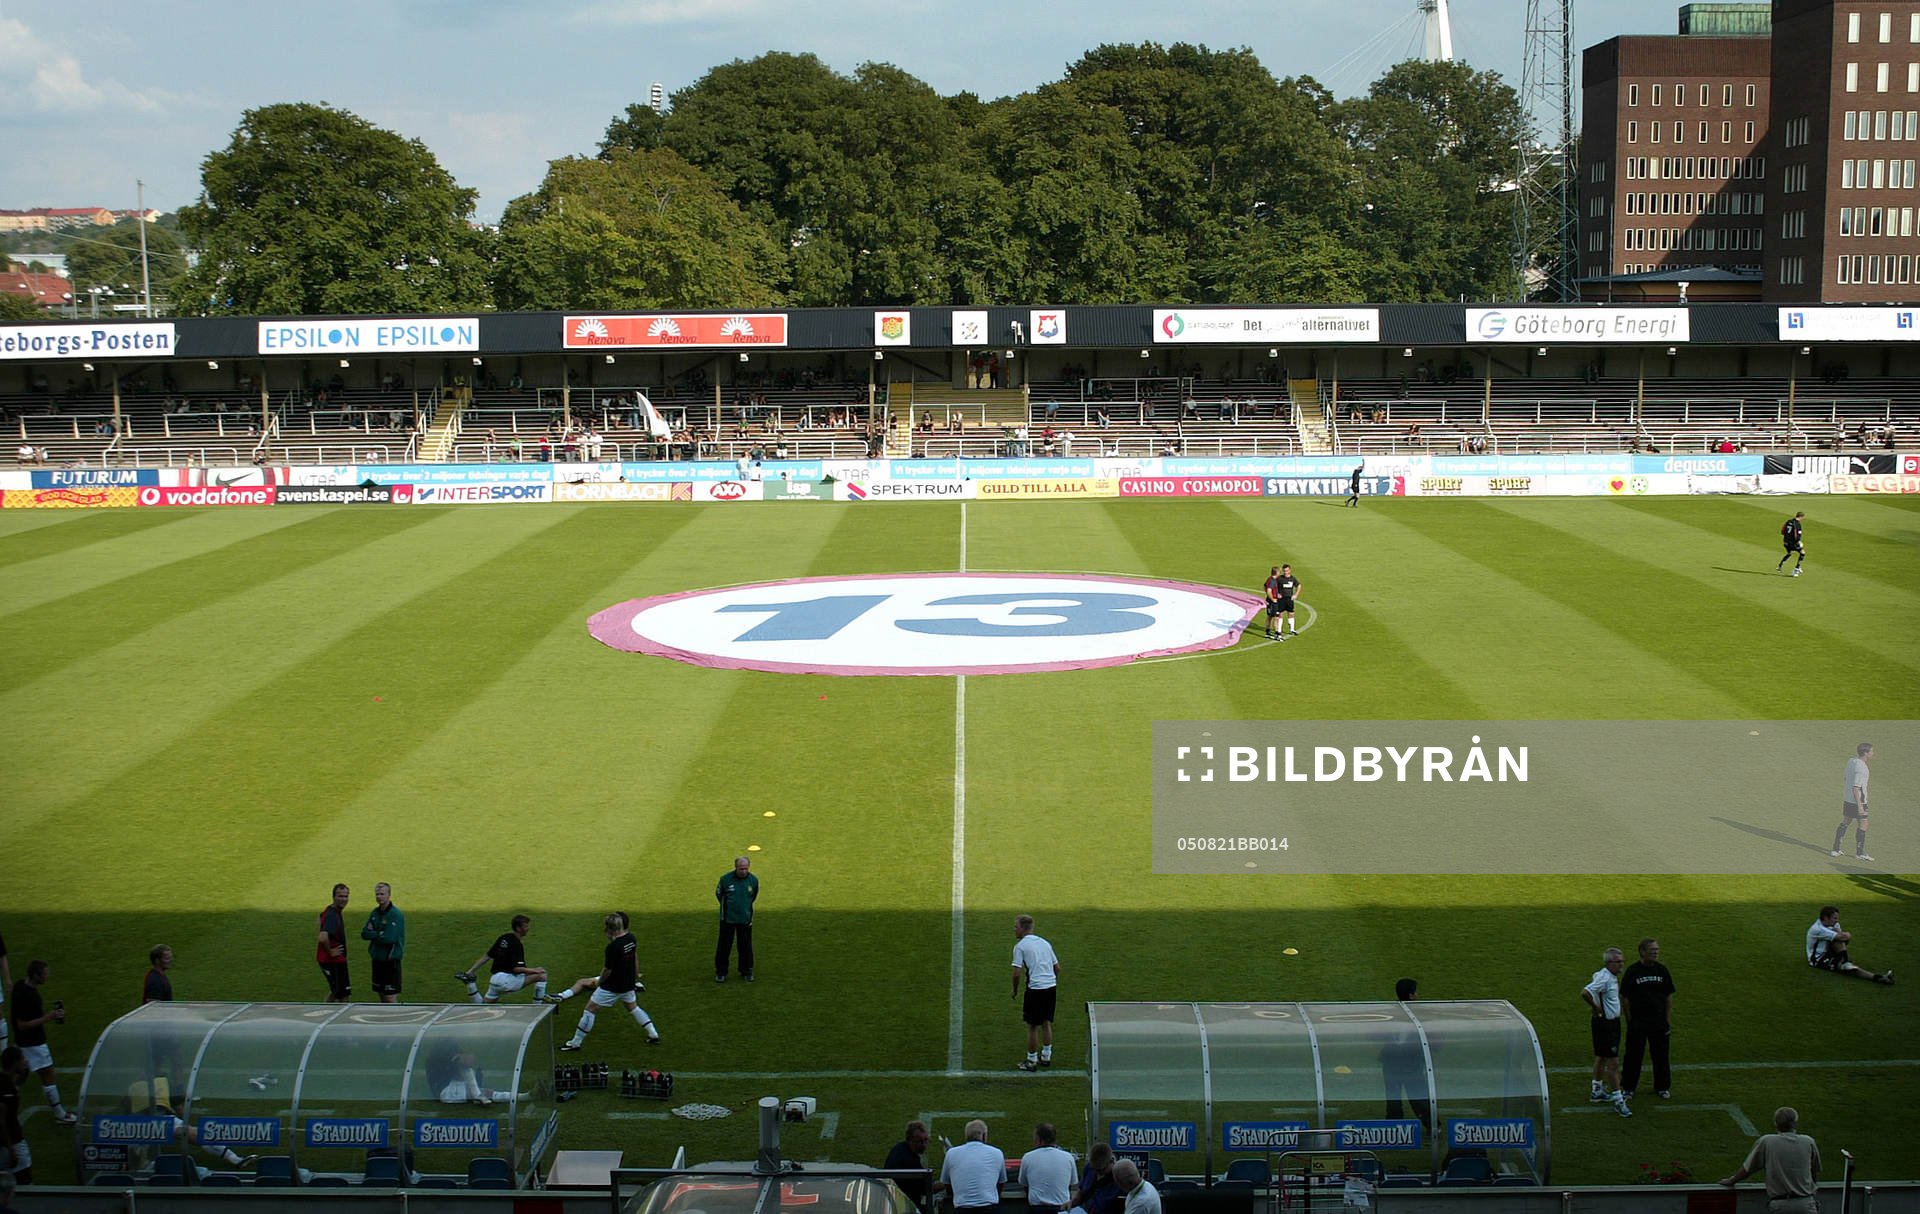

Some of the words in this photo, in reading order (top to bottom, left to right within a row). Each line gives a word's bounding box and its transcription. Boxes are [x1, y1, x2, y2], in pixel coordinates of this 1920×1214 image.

[1244, 320, 1262, 330] Det
[1302, 320, 1370, 330] alternativet
[1515, 315, 1606, 338] Göteborg
[1614, 315, 1676, 338] Energi
[587, 334, 625, 345] Renova
[660, 333, 697, 344] Renova
[733, 332, 771, 344] Renova
[52, 471, 138, 484] FUTURUM
[1420, 478, 1462, 490] SPORT
[1488, 478, 1530, 490] SPORT
[438, 486, 545, 500] INTERSPORT
[556, 484, 668, 499] HORNBACH
[712, 483, 744, 497] AXA
[872, 484, 962, 494] SPEKTRUM
[982, 484, 1020, 494] GULD
[1022, 484, 1050, 492] TILL
[1054, 484, 1088, 492] ALLA
[1122, 481, 1174, 493] CASINO
[1182, 480, 1260, 492] COSMOPOL
[1268, 479, 1378, 494] STRYKTIPET
[167, 488, 266, 504] vodafone
[278, 489, 388, 504] svenskaspel.se
[714, 592, 1159, 642] 13
[100, 1120, 166, 1140] STADIUM
[204, 1121, 272, 1141] STADIUM
[312, 1122, 382, 1144] STADIUM
[420, 1122, 490, 1144] STADIUM
[1116, 1125, 1189, 1146] STADIUM
[1454, 1122, 1526, 1144] STADIUM
